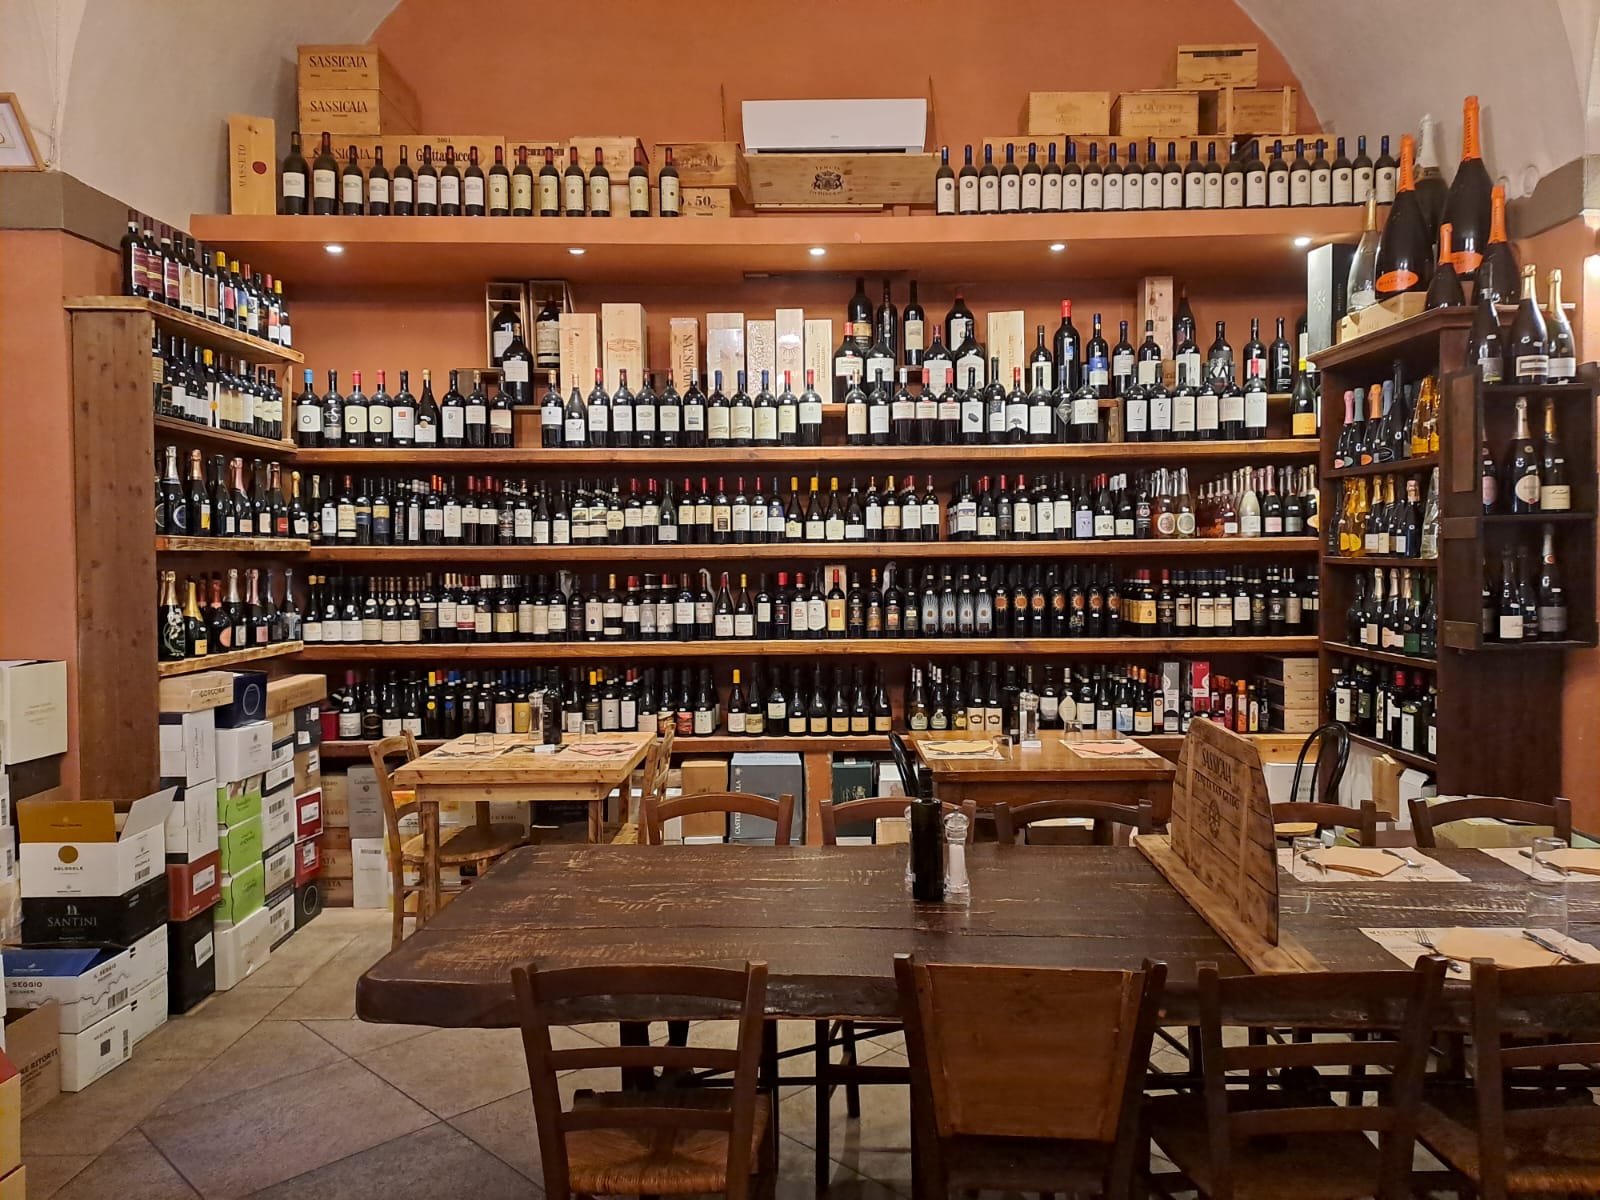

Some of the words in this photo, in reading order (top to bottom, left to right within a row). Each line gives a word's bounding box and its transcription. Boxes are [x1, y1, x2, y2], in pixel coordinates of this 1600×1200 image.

[309, 55, 367, 68] SASSICAIA
[310, 100, 368, 113] SASSICAIA
[238, 144, 247, 188] MASSETO
[1202, 748, 1232, 785] SASSICAIA
[48, 916, 97, 927] SANTINI
